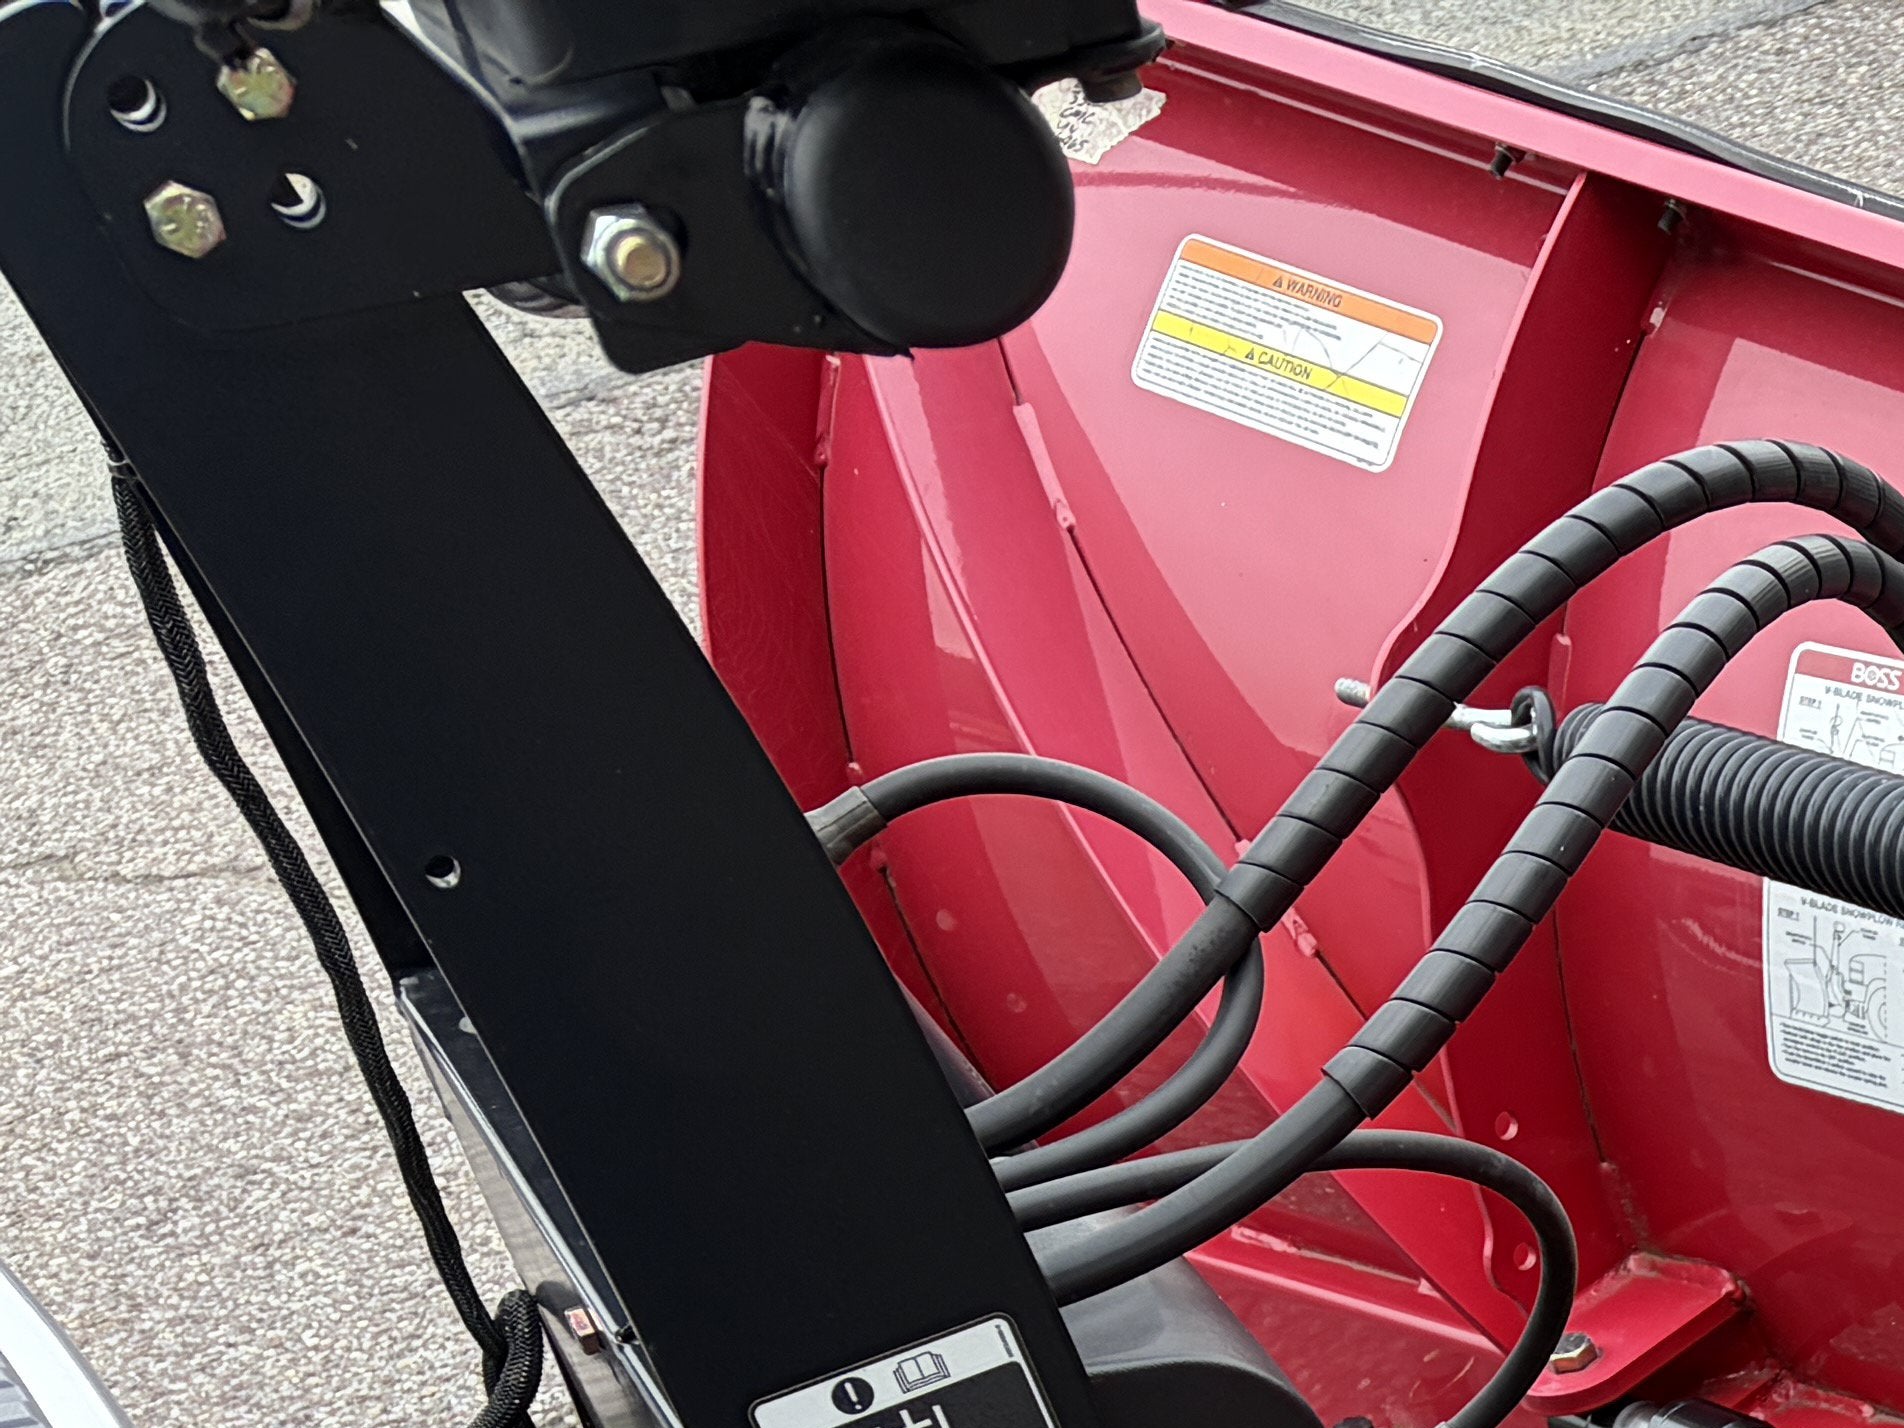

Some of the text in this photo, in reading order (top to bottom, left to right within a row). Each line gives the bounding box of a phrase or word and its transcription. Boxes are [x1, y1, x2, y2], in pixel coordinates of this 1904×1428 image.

[1286, 278, 1343, 309] WARNING
[1258, 351, 1312, 381] CAUTION
[1851, 662, 1902, 691] BOSS
